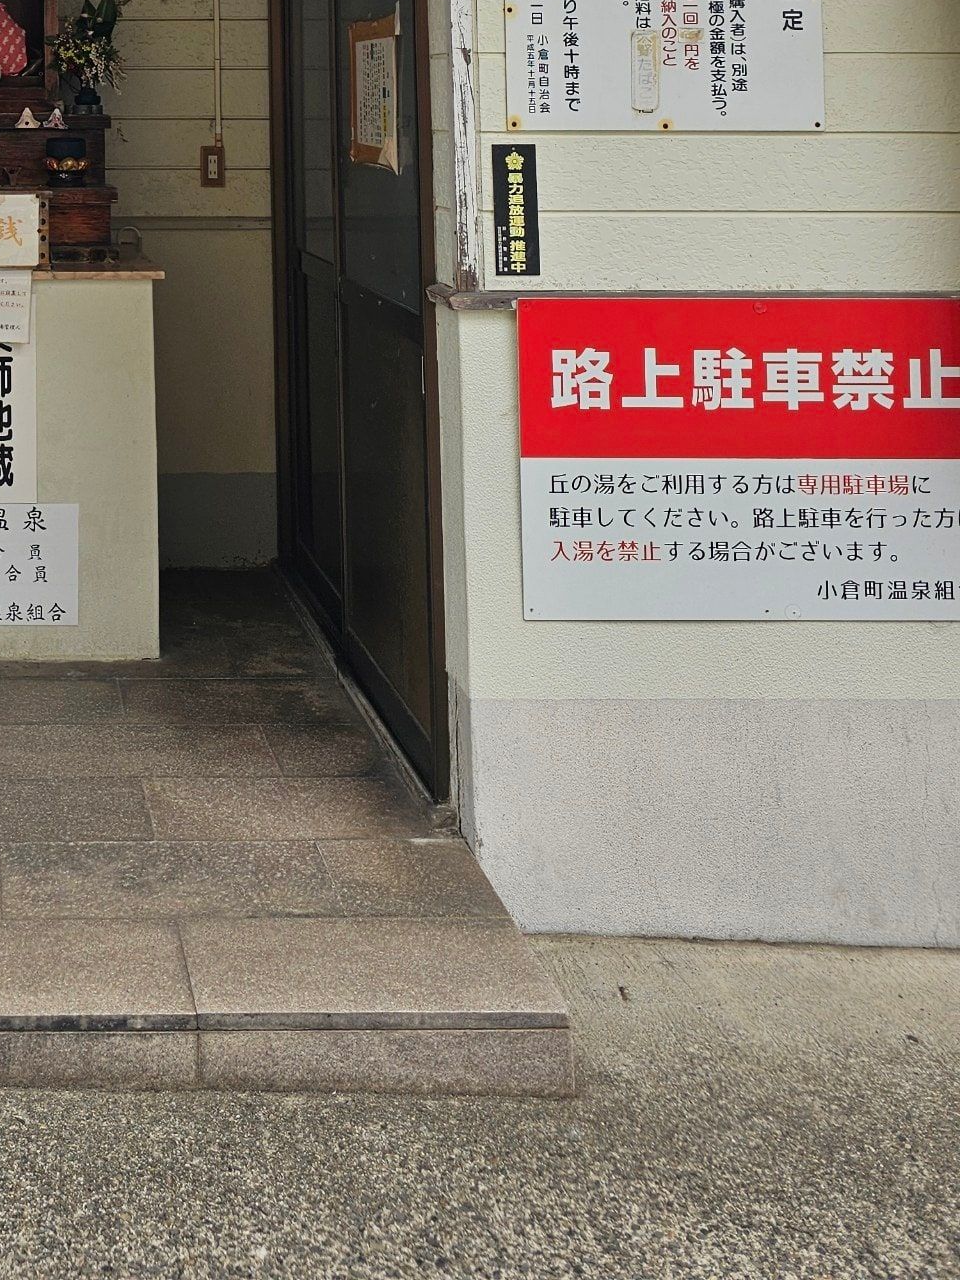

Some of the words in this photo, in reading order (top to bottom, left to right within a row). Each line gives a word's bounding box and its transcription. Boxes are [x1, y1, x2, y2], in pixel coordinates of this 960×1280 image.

[537, 35, 551, 113] 小倉町自治会
[550, 347, 960, 411] 路上駐車禁止
[549, 473, 932, 496] 丘の湯をご利用する方は専用駐車場に
[549, 506, 960, 529] 駐車してください。路上駐車を行った方
[550, 539, 900, 563] 入湯を禁止する場合がございます。
[817, 579, 960, 601] 小倉町温泉組
